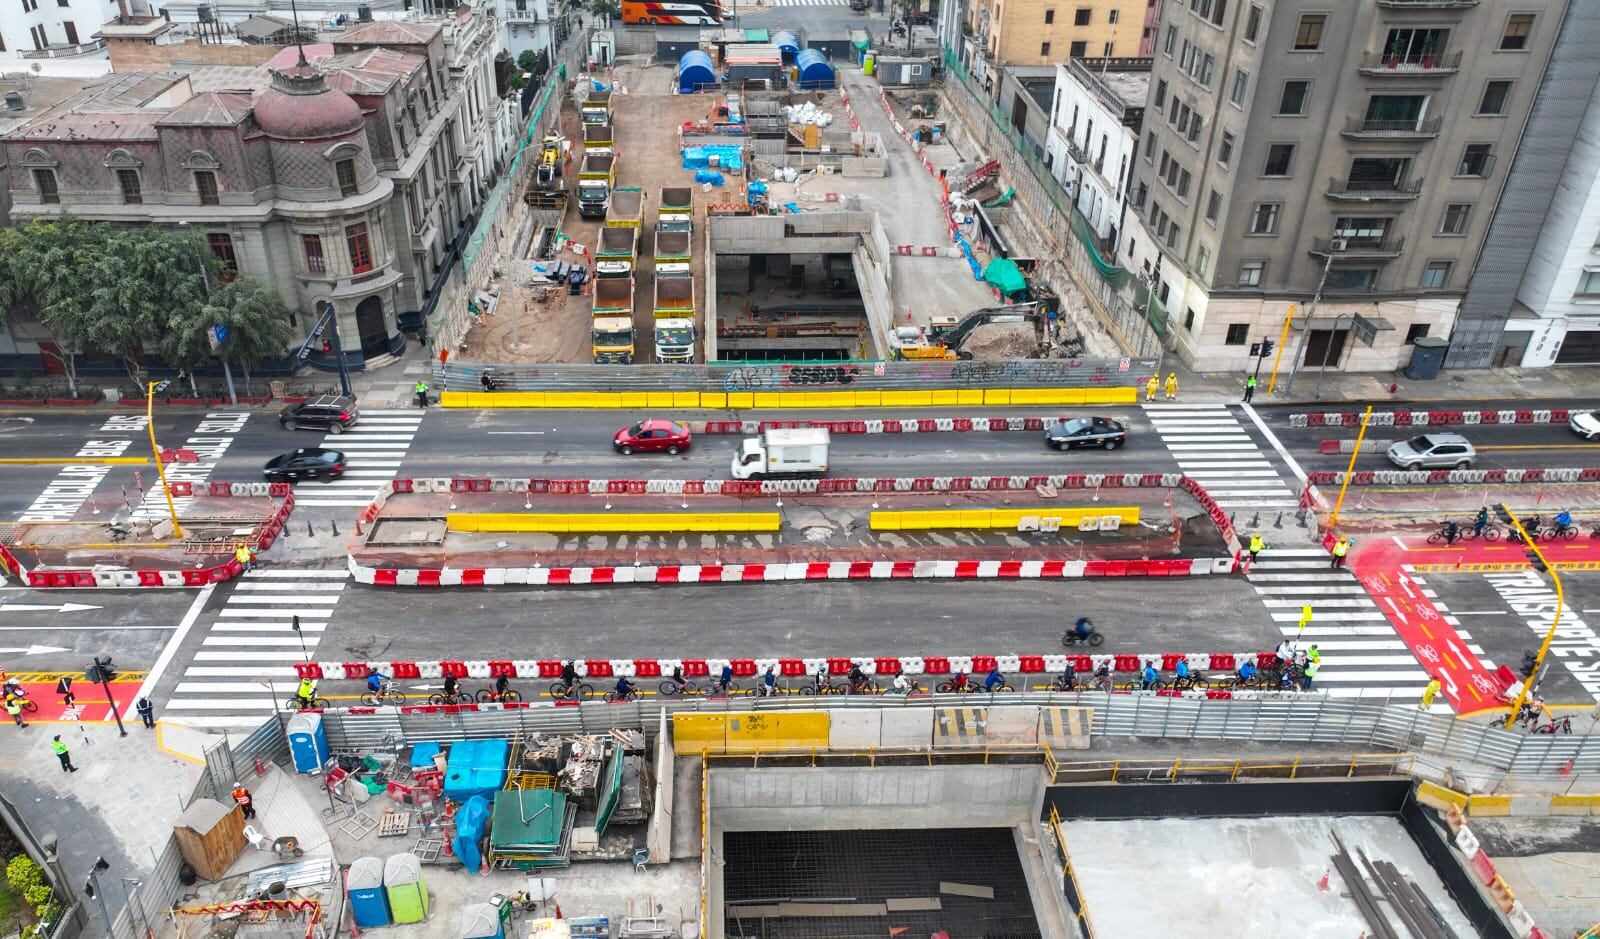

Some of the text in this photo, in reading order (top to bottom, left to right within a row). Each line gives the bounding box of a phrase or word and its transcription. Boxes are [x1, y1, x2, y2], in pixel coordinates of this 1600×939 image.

[100, 415, 152, 431] BUS
[195, 413, 250, 433] SOLO
[75, 440, 133, 457] BUS
[18, 465, 113, 522] PARTICULAR
[1482, 571, 1600, 657] TRANSPORTE
